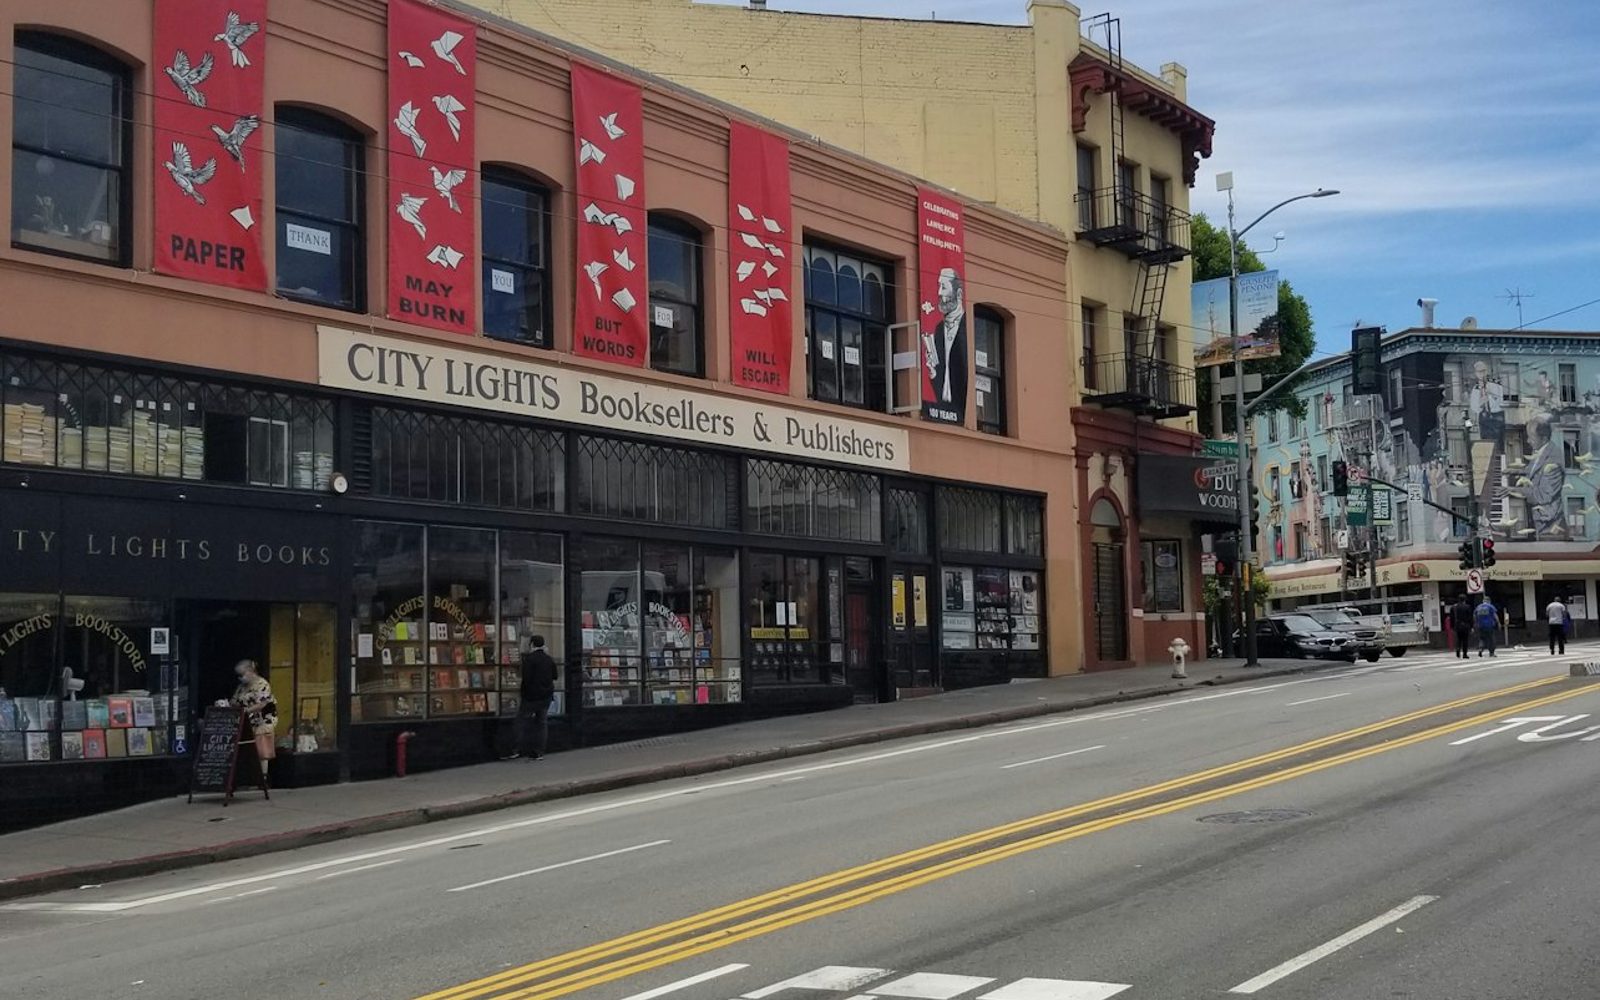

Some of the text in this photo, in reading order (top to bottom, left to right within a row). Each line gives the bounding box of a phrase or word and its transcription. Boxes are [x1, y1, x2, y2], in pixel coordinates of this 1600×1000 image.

[923, 201, 959, 220] CELEBRATING
[289, 229, 329, 248] THANK
[171, 234, 246, 271] PAPER
[405, 275, 453, 298] MAY
[494, 273, 512, 288] YOU
[400, 297, 465, 325] BURN
[657, 311, 671, 323] FOR
[595, 317, 622, 335] BUT
[583, 335, 635, 359] WORDS
[745, 349, 777, 366] WILL
[742, 367, 780, 386] ESCAPE
[348, 343, 894, 461] CITY LIGHTS Booksellers & Publishers
[939, 408, 957, 421] YEARS
[88, 534, 210, 560] LIGHTS
[238, 543, 330, 566] BOOKS
[391, 595, 425, 623] LIGHTS
[610, 601, 637, 624] LIGHTS
[2, 612, 147, 673] LIGHTS BOOKSTORE
